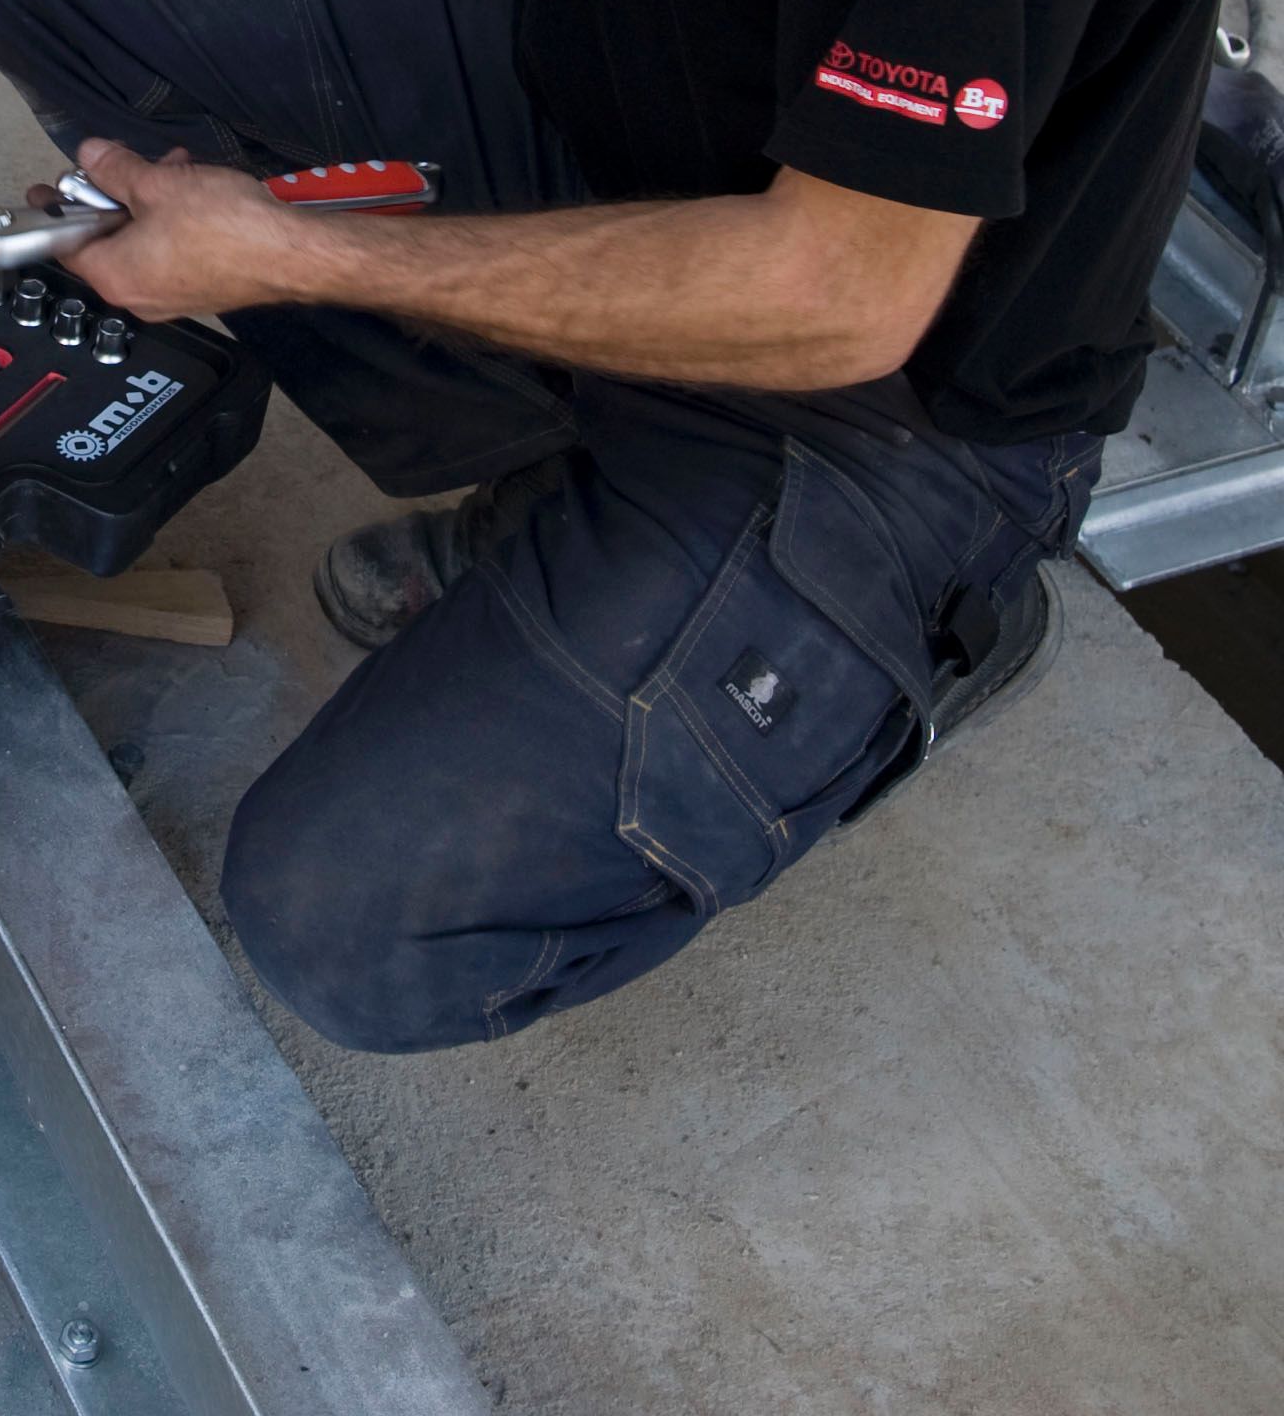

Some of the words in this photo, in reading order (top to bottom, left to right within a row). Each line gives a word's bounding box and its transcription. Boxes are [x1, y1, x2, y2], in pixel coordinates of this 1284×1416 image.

[858, 51, 949, 98] TOYOTA
[877, 92, 943, 118] EQUIPMENT
[961, 86, 1005, 119] BT
[115, 387, 177, 441] PEDDINGHAUS
[725, 682, 768, 729] MASCOT
